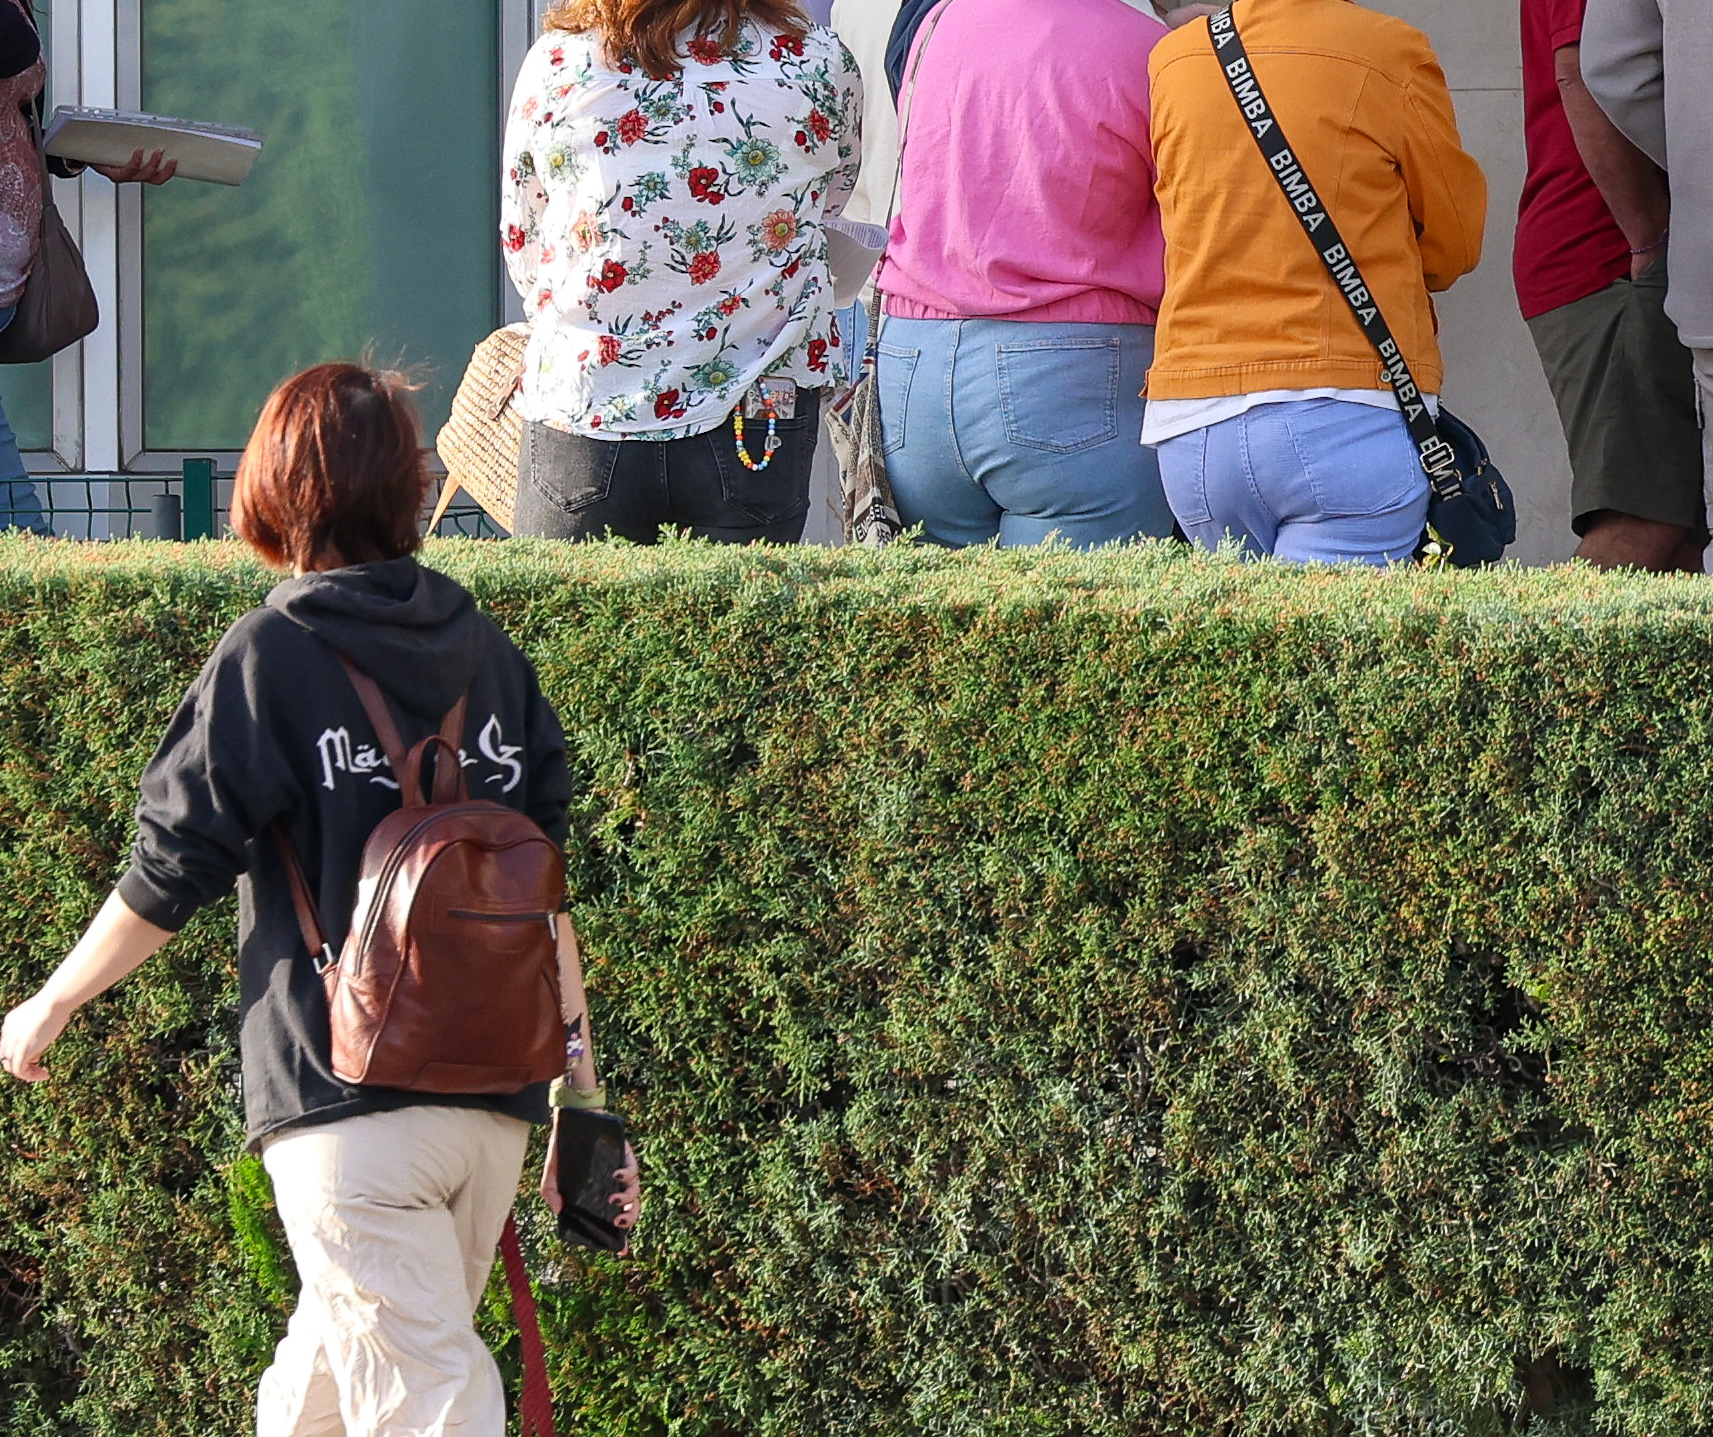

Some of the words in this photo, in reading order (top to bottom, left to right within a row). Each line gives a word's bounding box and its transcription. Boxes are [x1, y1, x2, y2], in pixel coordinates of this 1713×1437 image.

[1225, 56, 1273, 139] BIMBA
[1269, 148, 1327, 233] BIMBA
[1322, 242, 1378, 326] BIMBA
[1377, 337, 1425, 424] BIMBA
